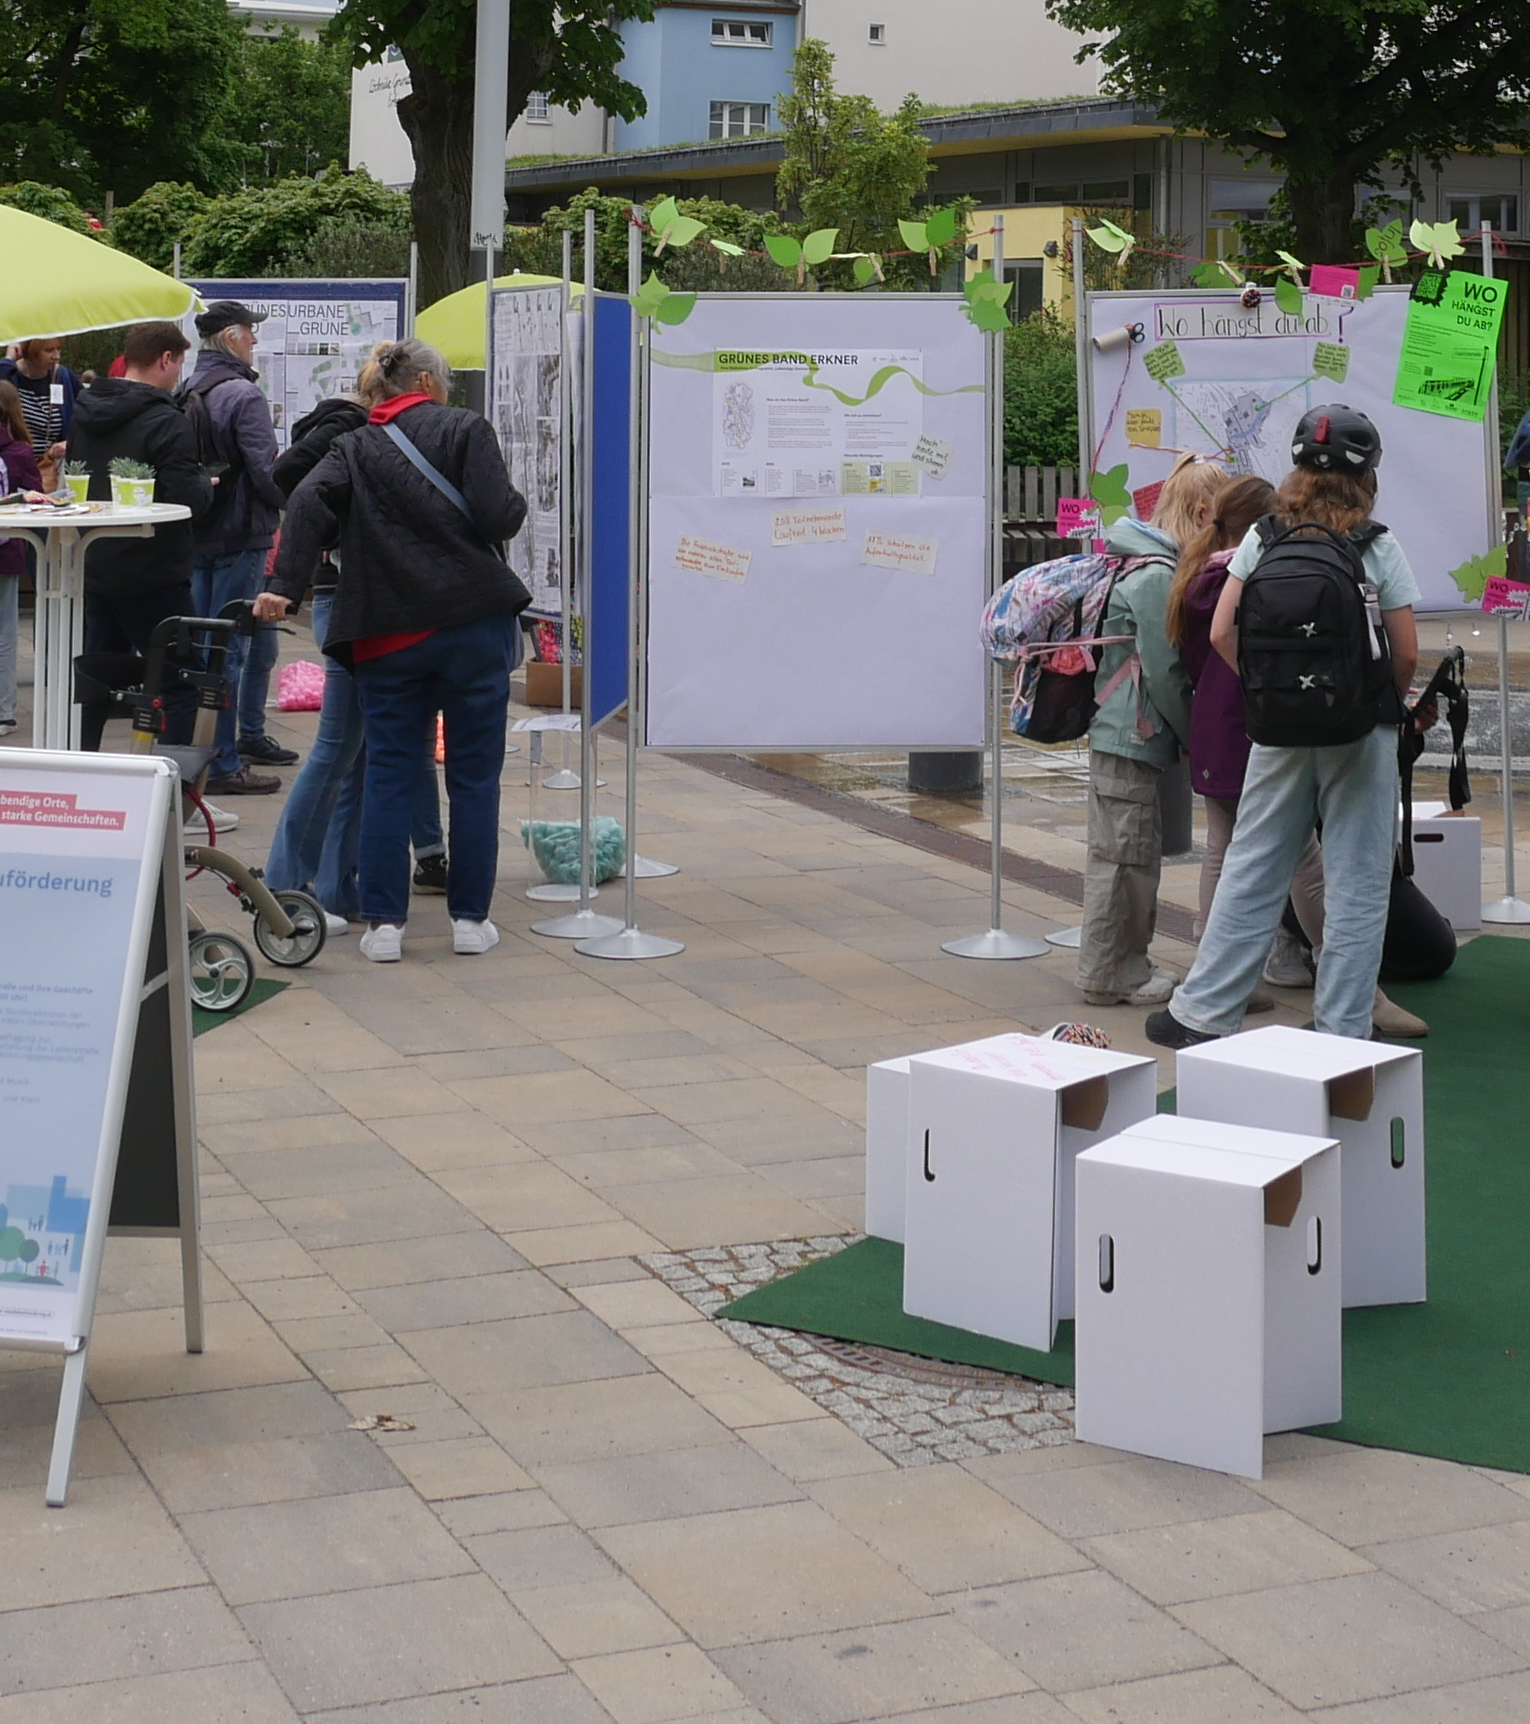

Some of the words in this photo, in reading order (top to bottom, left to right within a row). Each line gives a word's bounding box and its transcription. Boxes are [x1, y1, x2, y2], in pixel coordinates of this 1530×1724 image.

[1463, 280, 1498, 304] WO
[288, 304, 345, 319] URBANE
[1451, 299, 1496, 318] HÄNGST
[300, 320, 349, 336] GRÜNE
[1157, 307, 1189, 337] Wo
[1201, 305, 1263, 338] hängst
[1456, 314, 1472, 327] DU
[1473, 318, 1494, 331] AB?
[718, 351, 769, 364] GRÜNES
[772, 354, 807, 365] BAND
[810, 354, 859, 365] ERKNER
[1061, 503, 1080, 514] WO
[1489, 580, 1509, 593] WO
[43, 796, 69, 810] Orte,
[1, 810, 32, 822] starke
[34, 811, 119, 826] Gemeinschaften.
